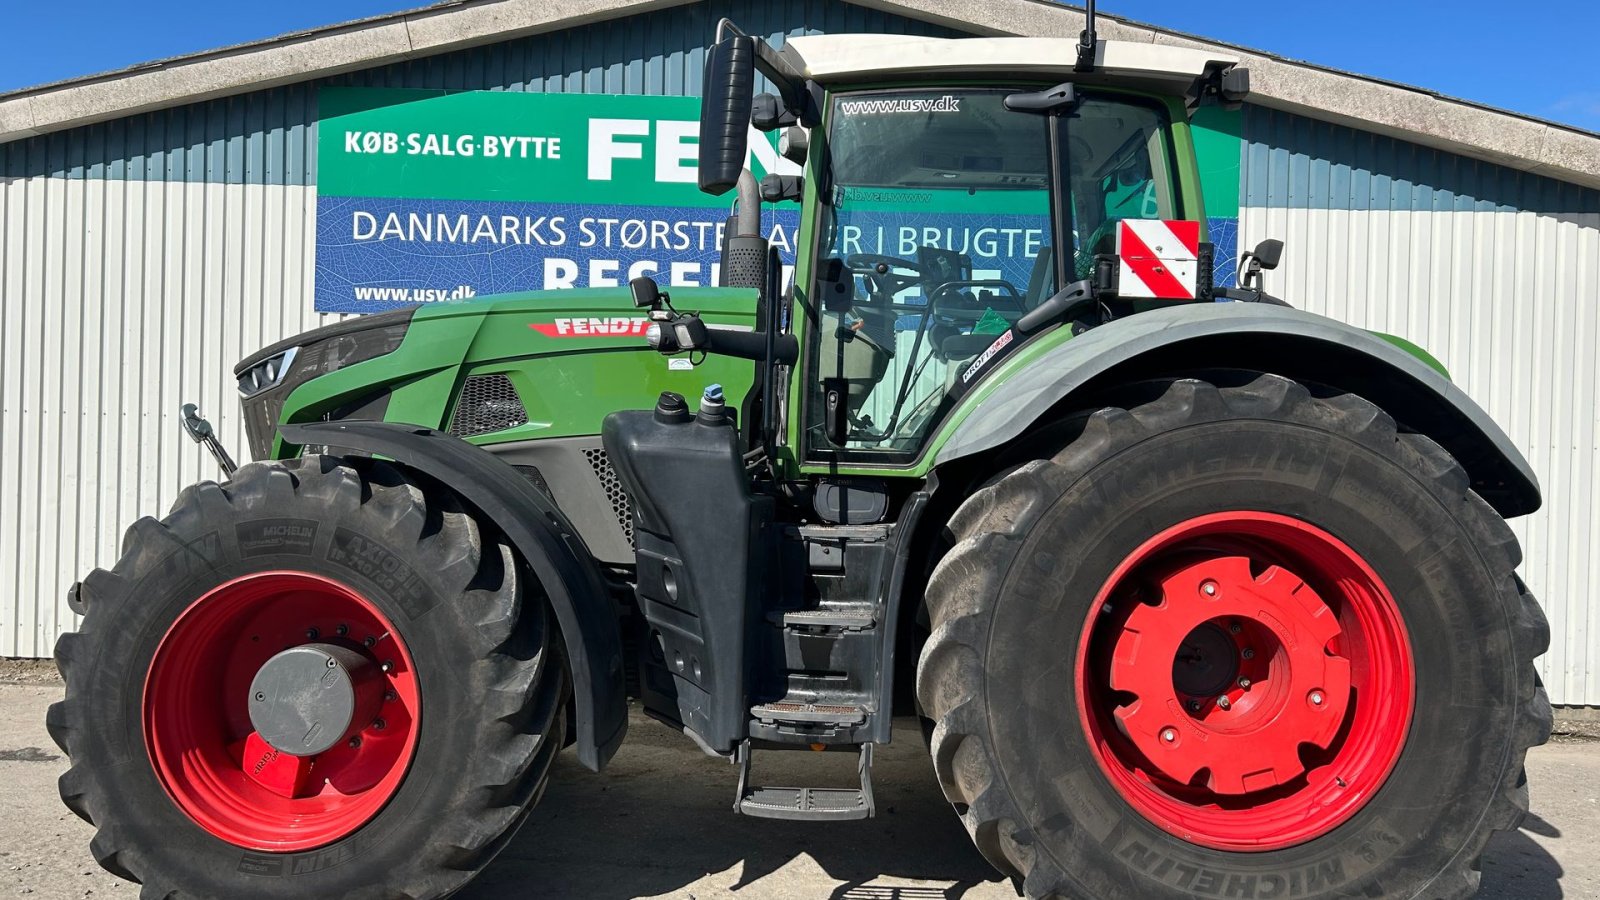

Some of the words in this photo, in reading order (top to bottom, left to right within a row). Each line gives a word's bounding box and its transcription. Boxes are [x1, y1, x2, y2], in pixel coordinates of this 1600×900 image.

[842, 95, 961, 114] www.usv.dk
[352, 211, 566, 247] DANMARKS
[579, 217, 727, 253] STØRSTE
[877, 226, 884, 255] I
[899, 227, 1043, 258] BRUGTE
[354, 285, 477, 302] www.usv.dk
[554, 317, 649, 335] FENDT
[263, 525, 313, 538] MICHELIN
[1115, 838, 1347, 899] MICHELIN
